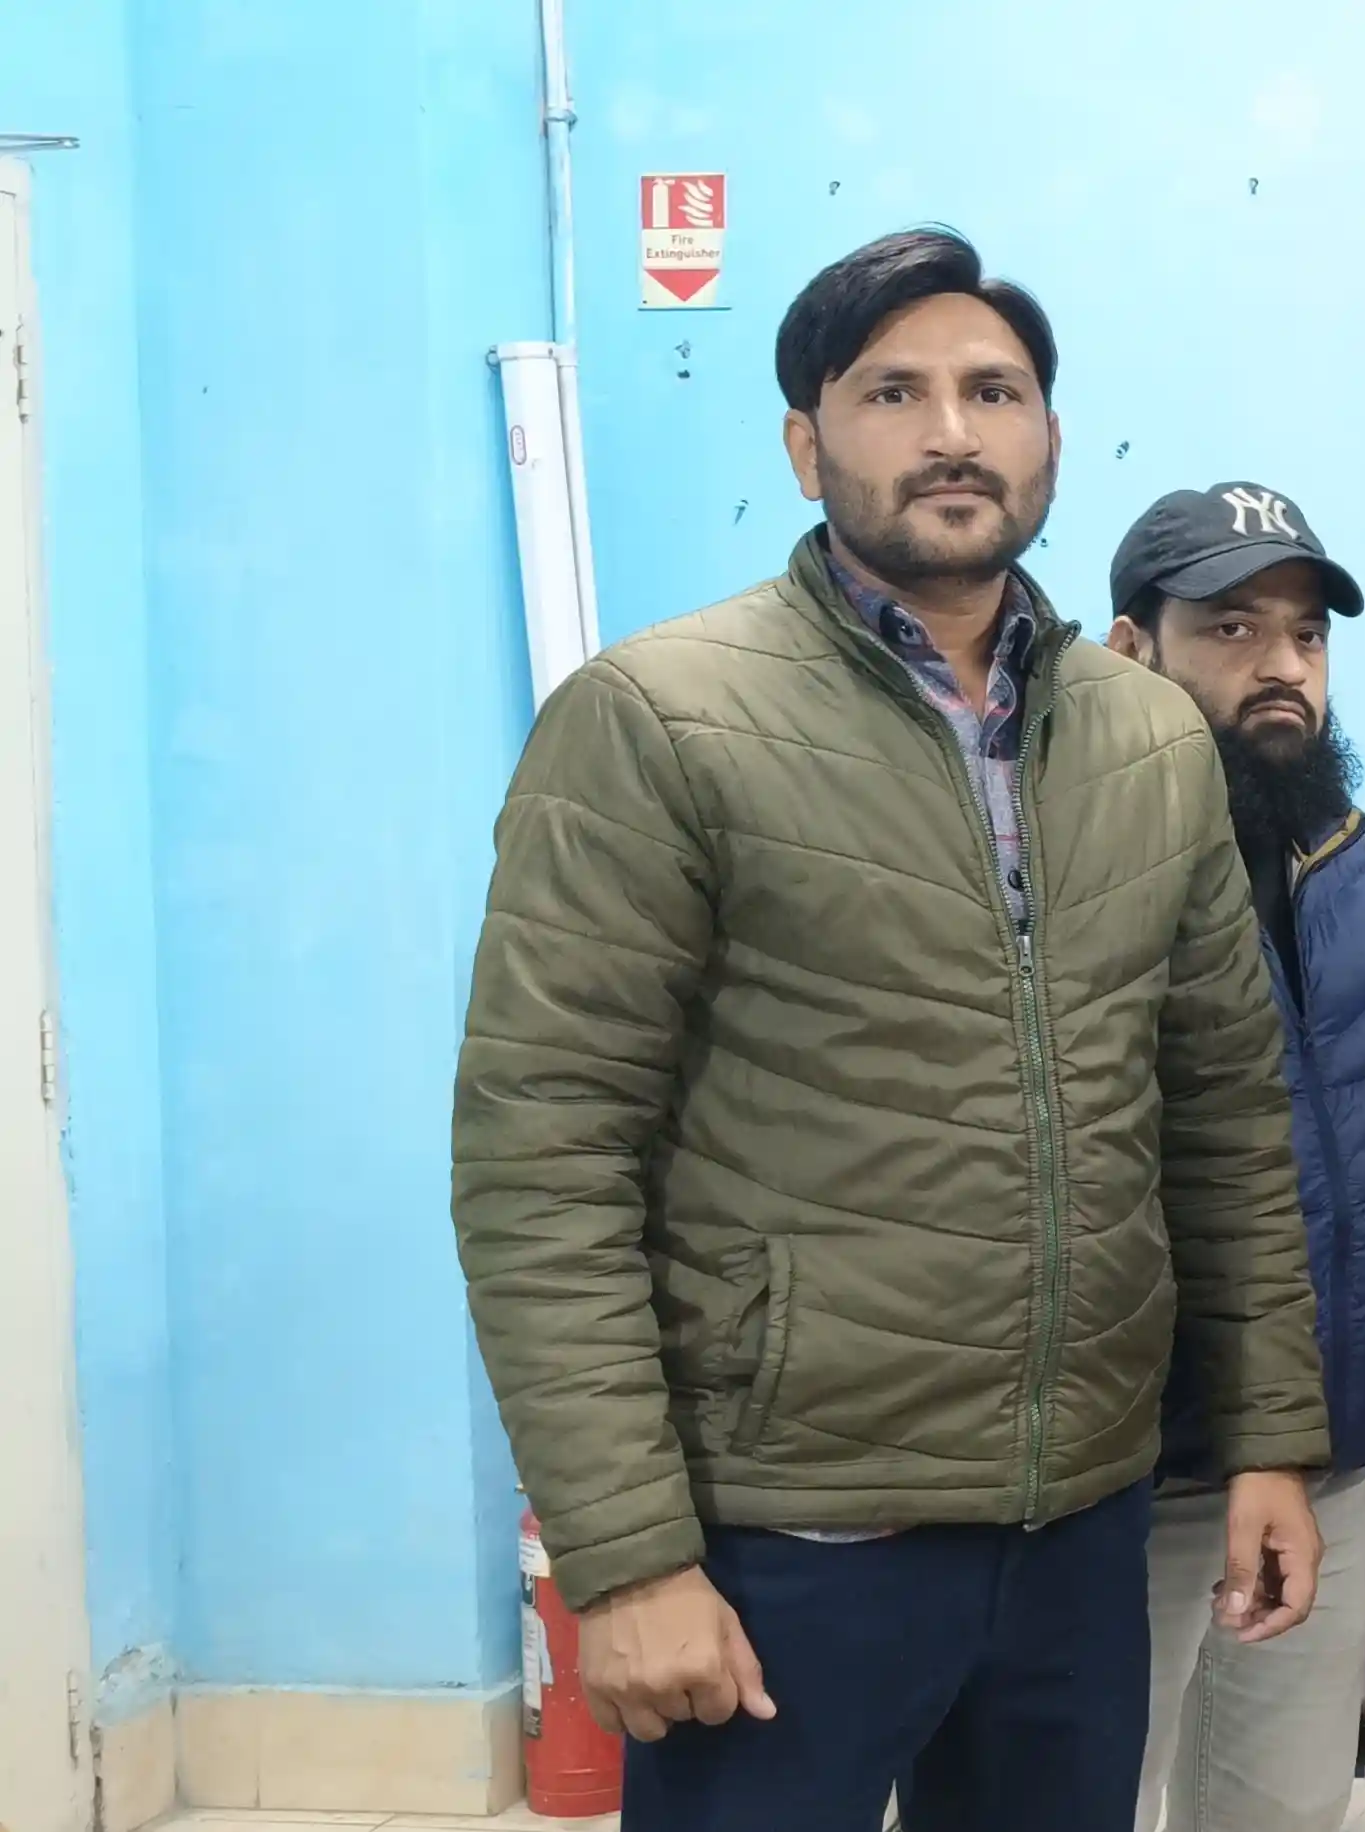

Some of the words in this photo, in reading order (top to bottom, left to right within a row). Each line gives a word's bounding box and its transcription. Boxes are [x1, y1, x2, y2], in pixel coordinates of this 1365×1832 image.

[671, 234, 694, 245] Fire
[646, 248, 720, 261] Extinguisher
[1222, 487, 1301, 540] NY
